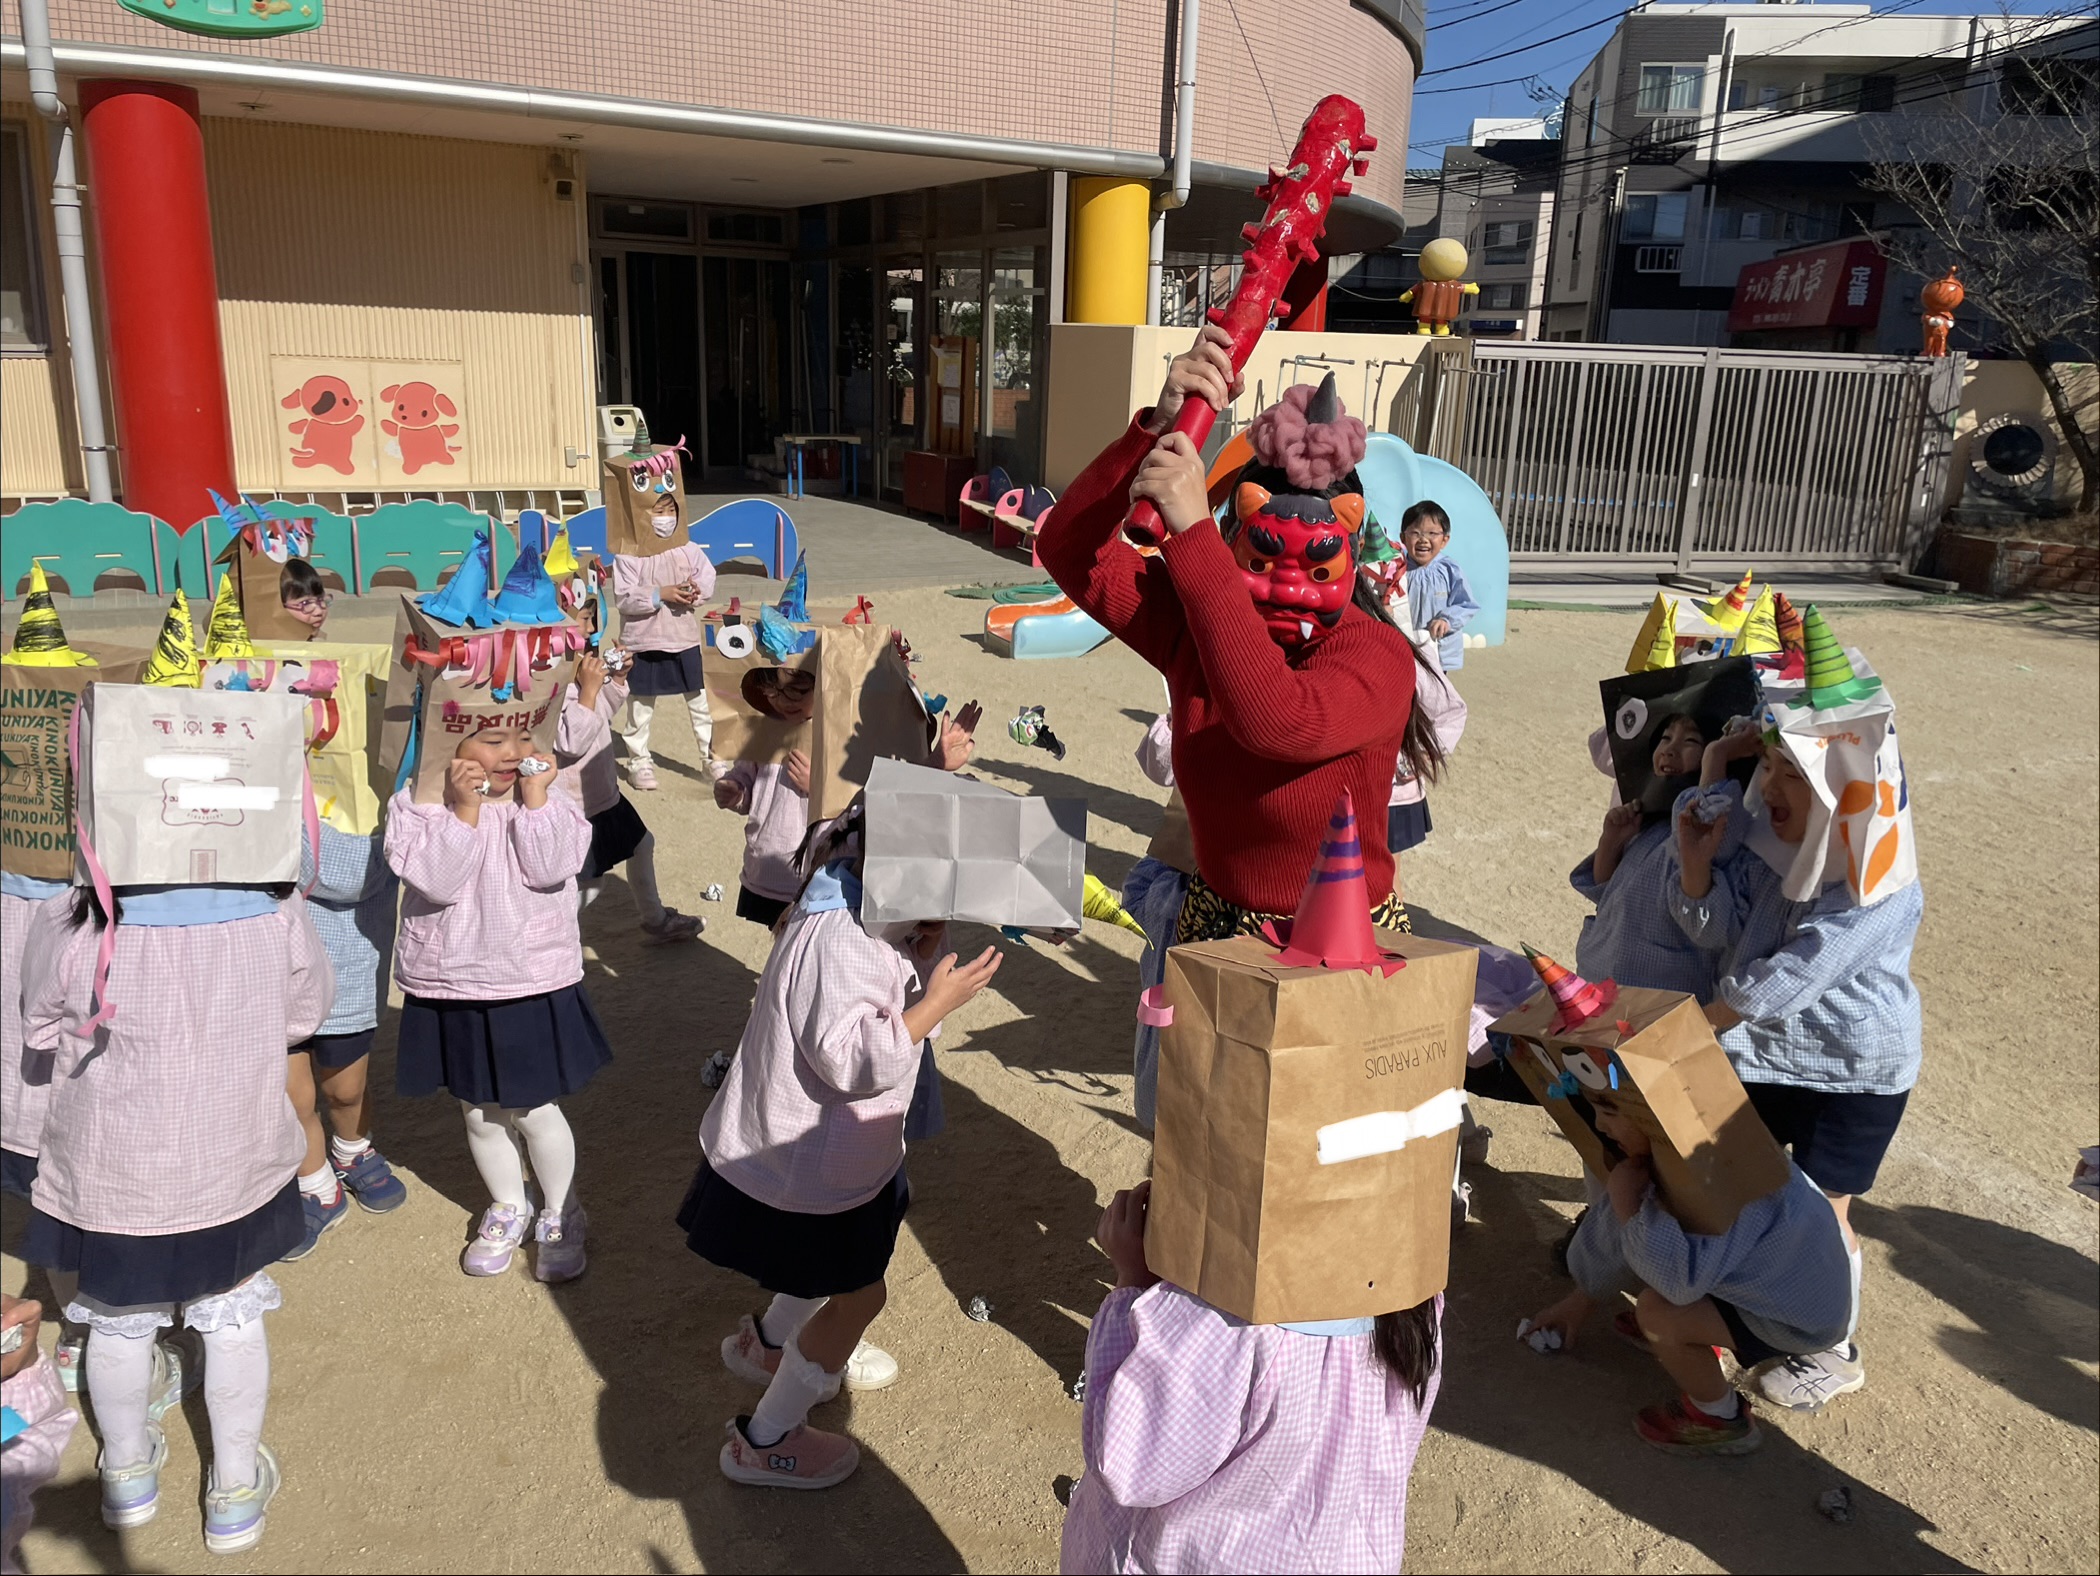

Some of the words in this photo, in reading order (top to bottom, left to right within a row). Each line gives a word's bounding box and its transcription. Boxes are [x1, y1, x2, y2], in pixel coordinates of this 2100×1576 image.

[1847, 266, 1871, 306] 定番
[45, 716, 65, 812] KINOKUNIYA
[1364, 1047, 1420, 1080] PARADIS
[1422, 1039, 1447, 1064] AUX
